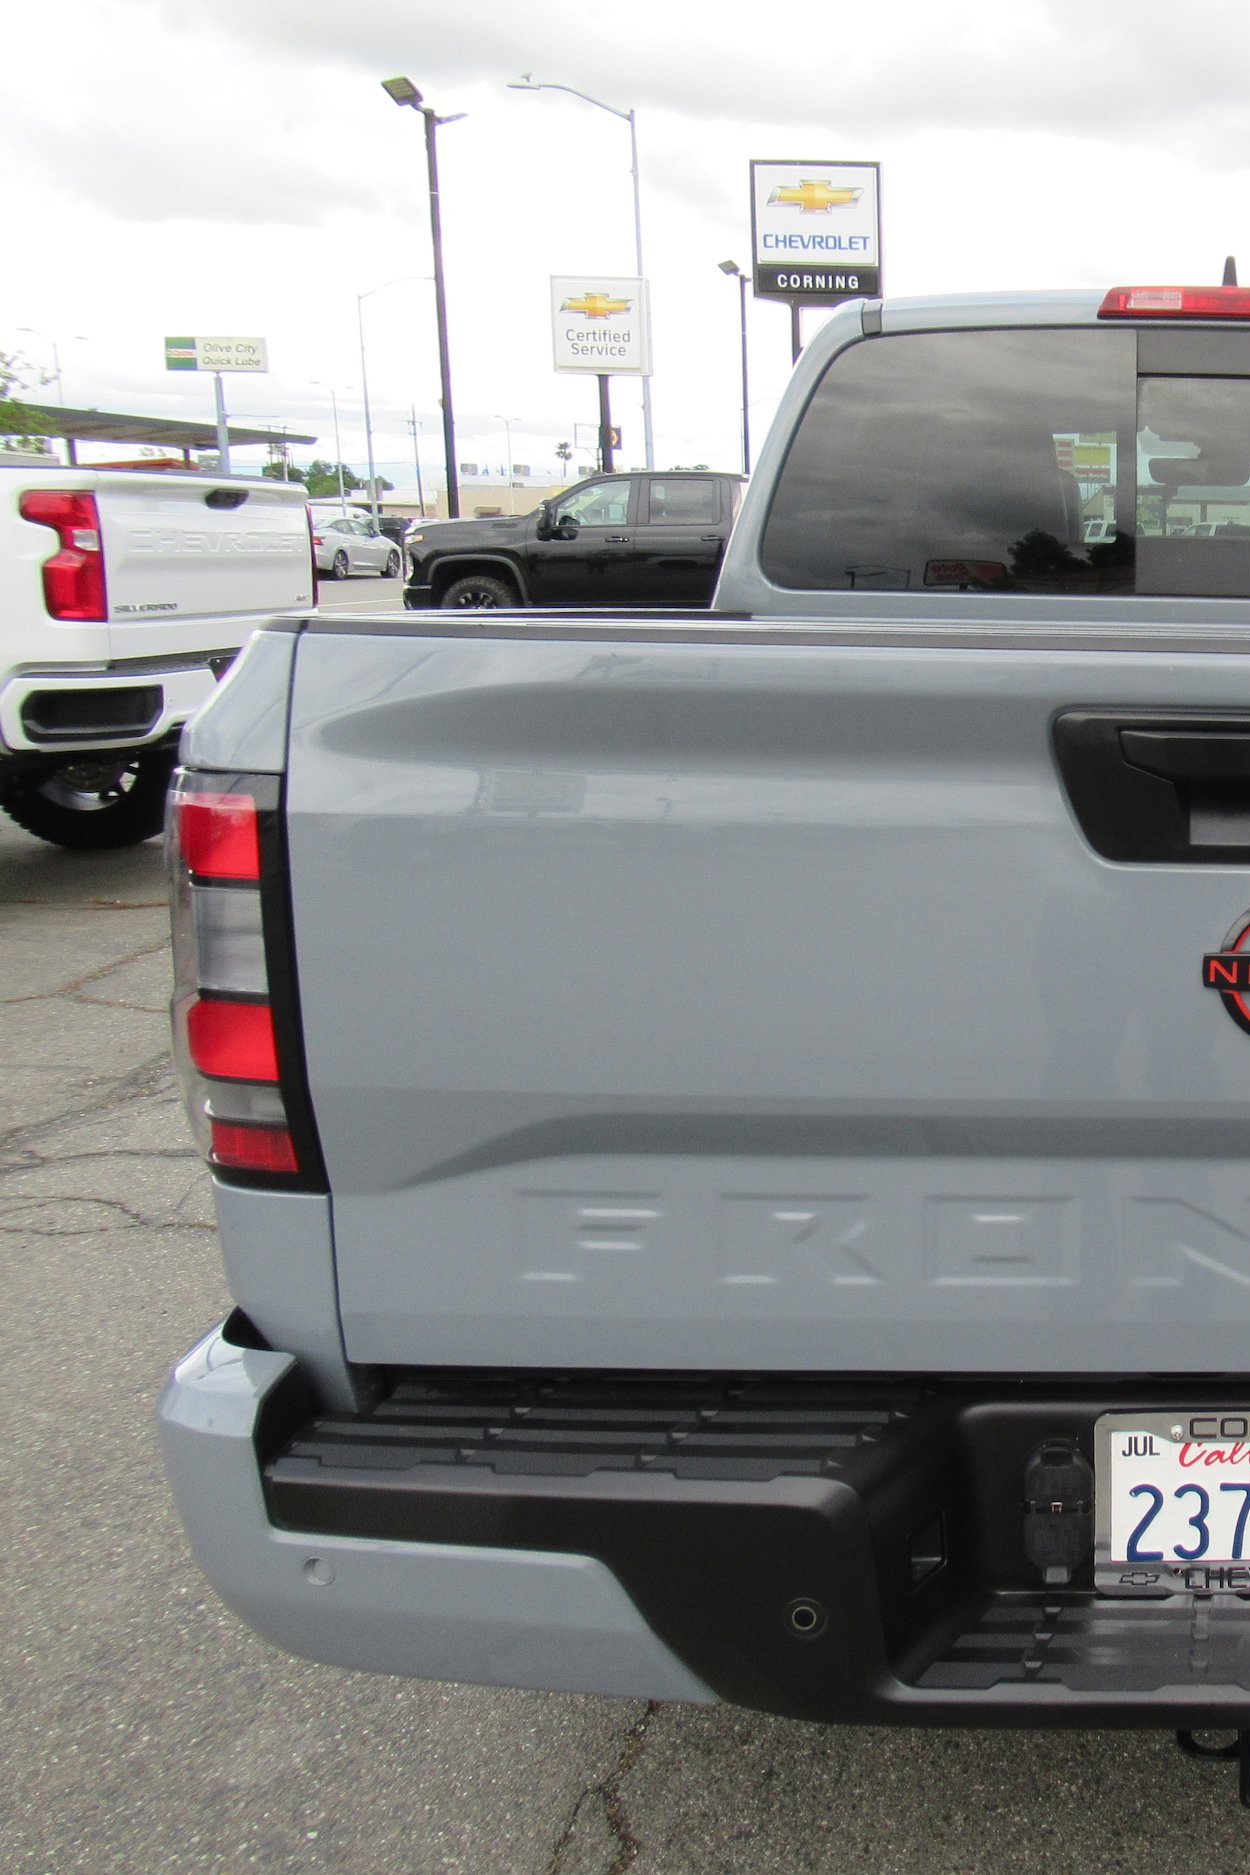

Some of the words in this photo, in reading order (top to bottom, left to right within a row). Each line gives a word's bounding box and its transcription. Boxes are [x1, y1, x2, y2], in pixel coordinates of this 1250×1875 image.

[763, 234, 870, 250] CHEVROLET
[777, 274, 859, 289] CORNING
[566, 329, 631, 343] Certified
[203, 343, 232, 353] Olive
[235, 343, 257, 354] City
[571, 343, 626, 356] Service
[203, 357, 232, 366] Quick
[235, 357, 261, 366] Lube
[129, 530, 306, 553] CHEVROLET
[1121, 1435, 1161, 1457] JUL
